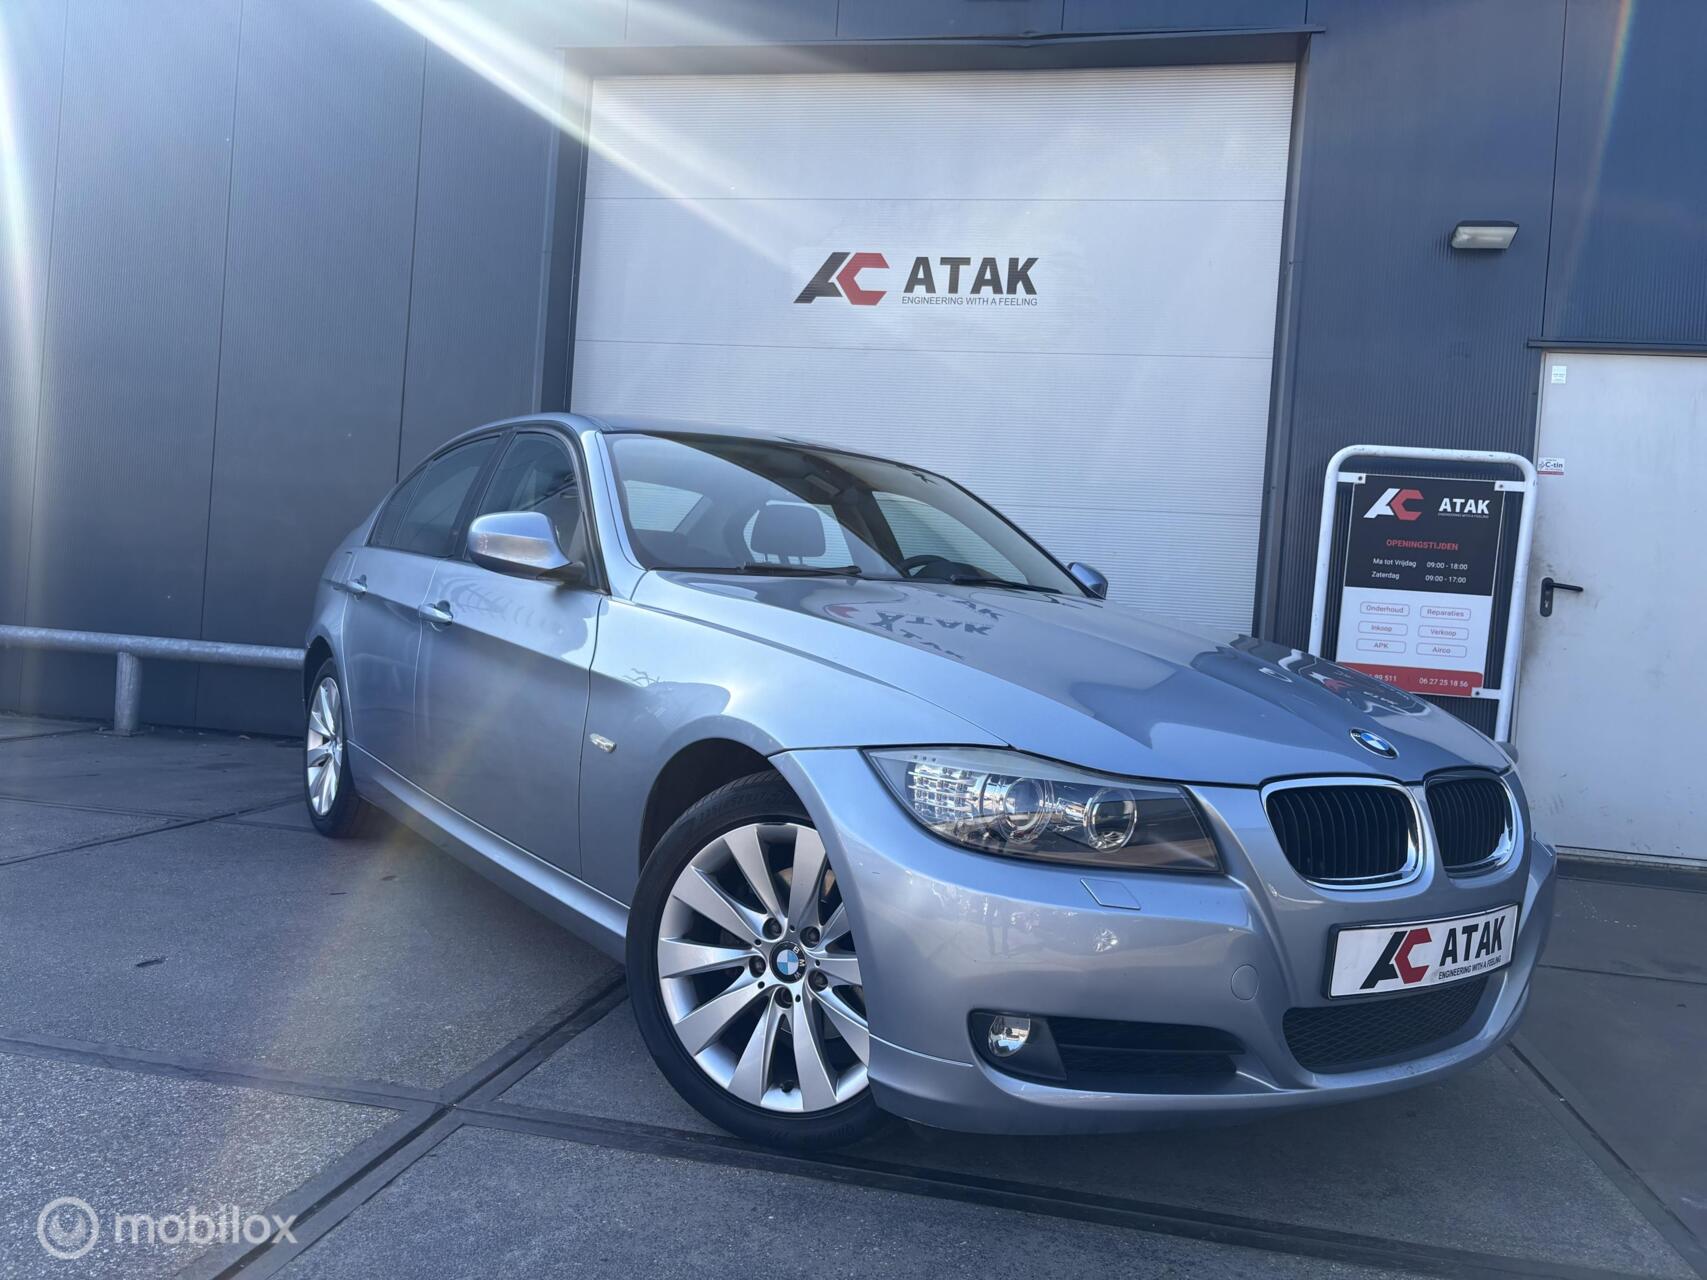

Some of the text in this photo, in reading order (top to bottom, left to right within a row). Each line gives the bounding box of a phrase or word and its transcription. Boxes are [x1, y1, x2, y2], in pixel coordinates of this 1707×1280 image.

[903, 256, 1039, 295] ATAK
[902, 296, 1038, 306] ENGINEERING WITH A FEELING
[1438, 498, 1490, 514] ATAK
[1386, 539, 1459, 551] OPENINGSTIJDEN
[1395, 560, 1417, 568] Vrijdag
[1426, 561, 1445, 569] 09:00
[1371, 571, 1400, 580] Zaterdag
[1366, 604, 1404, 613] Onderhoud
[1427, 608, 1464, 618] Reparaties
[1430, 628, 1457, 637] Verkoop
[1432, 646, 1451, 654] Airco
[1439, 915, 1506, 967] ATAK
[1438, 966, 1472, 980] ENGINEERING
[1472, 962, 1483, 972] WITH
